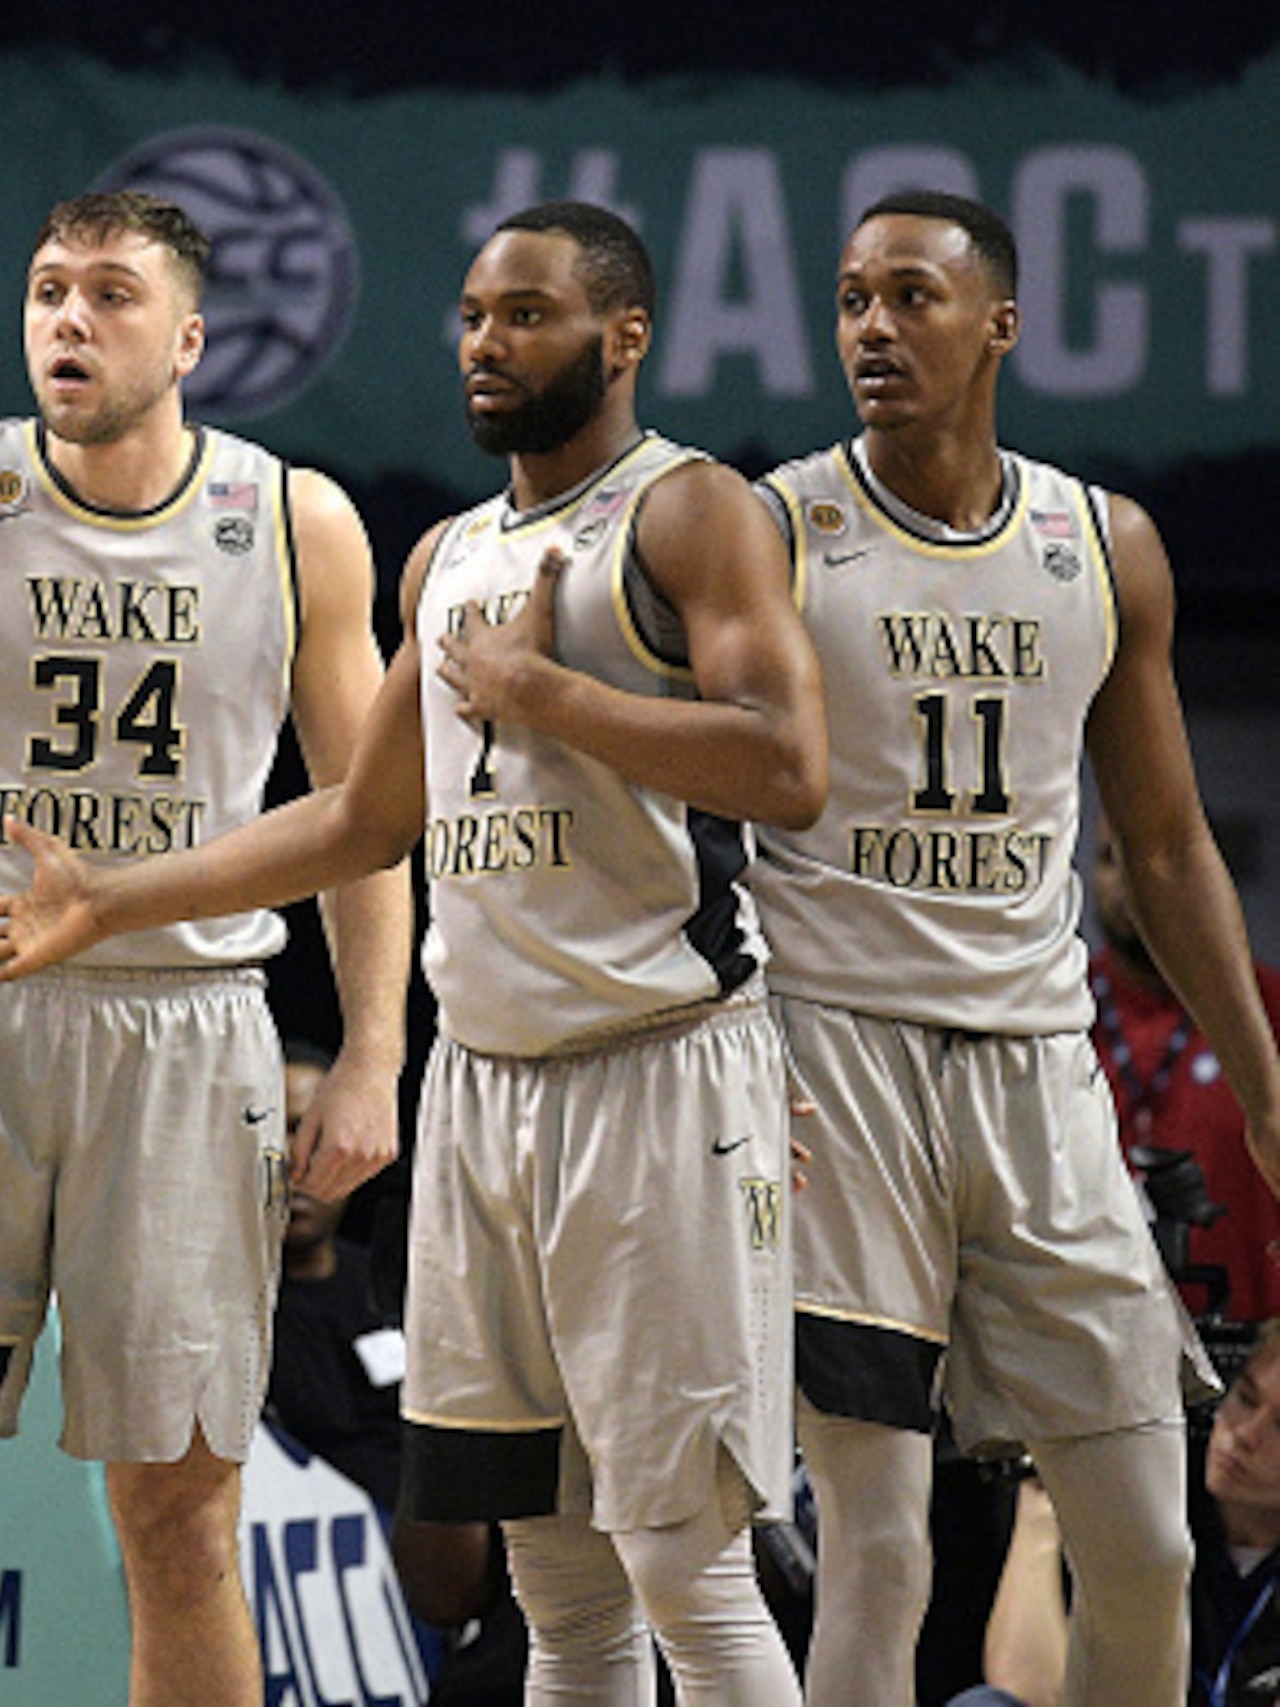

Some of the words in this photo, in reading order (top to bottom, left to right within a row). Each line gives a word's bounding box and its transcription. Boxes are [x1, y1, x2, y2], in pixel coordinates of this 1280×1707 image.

[27, 577, 200, 643] WAKE
[879, 614, 1044, 680] WAKE
[27, 655, 183, 778] 34
[913, 694, 1011, 815] 11
[425, 809, 573, 878] OREST
[851, 826, 1053, 894] FOREST
